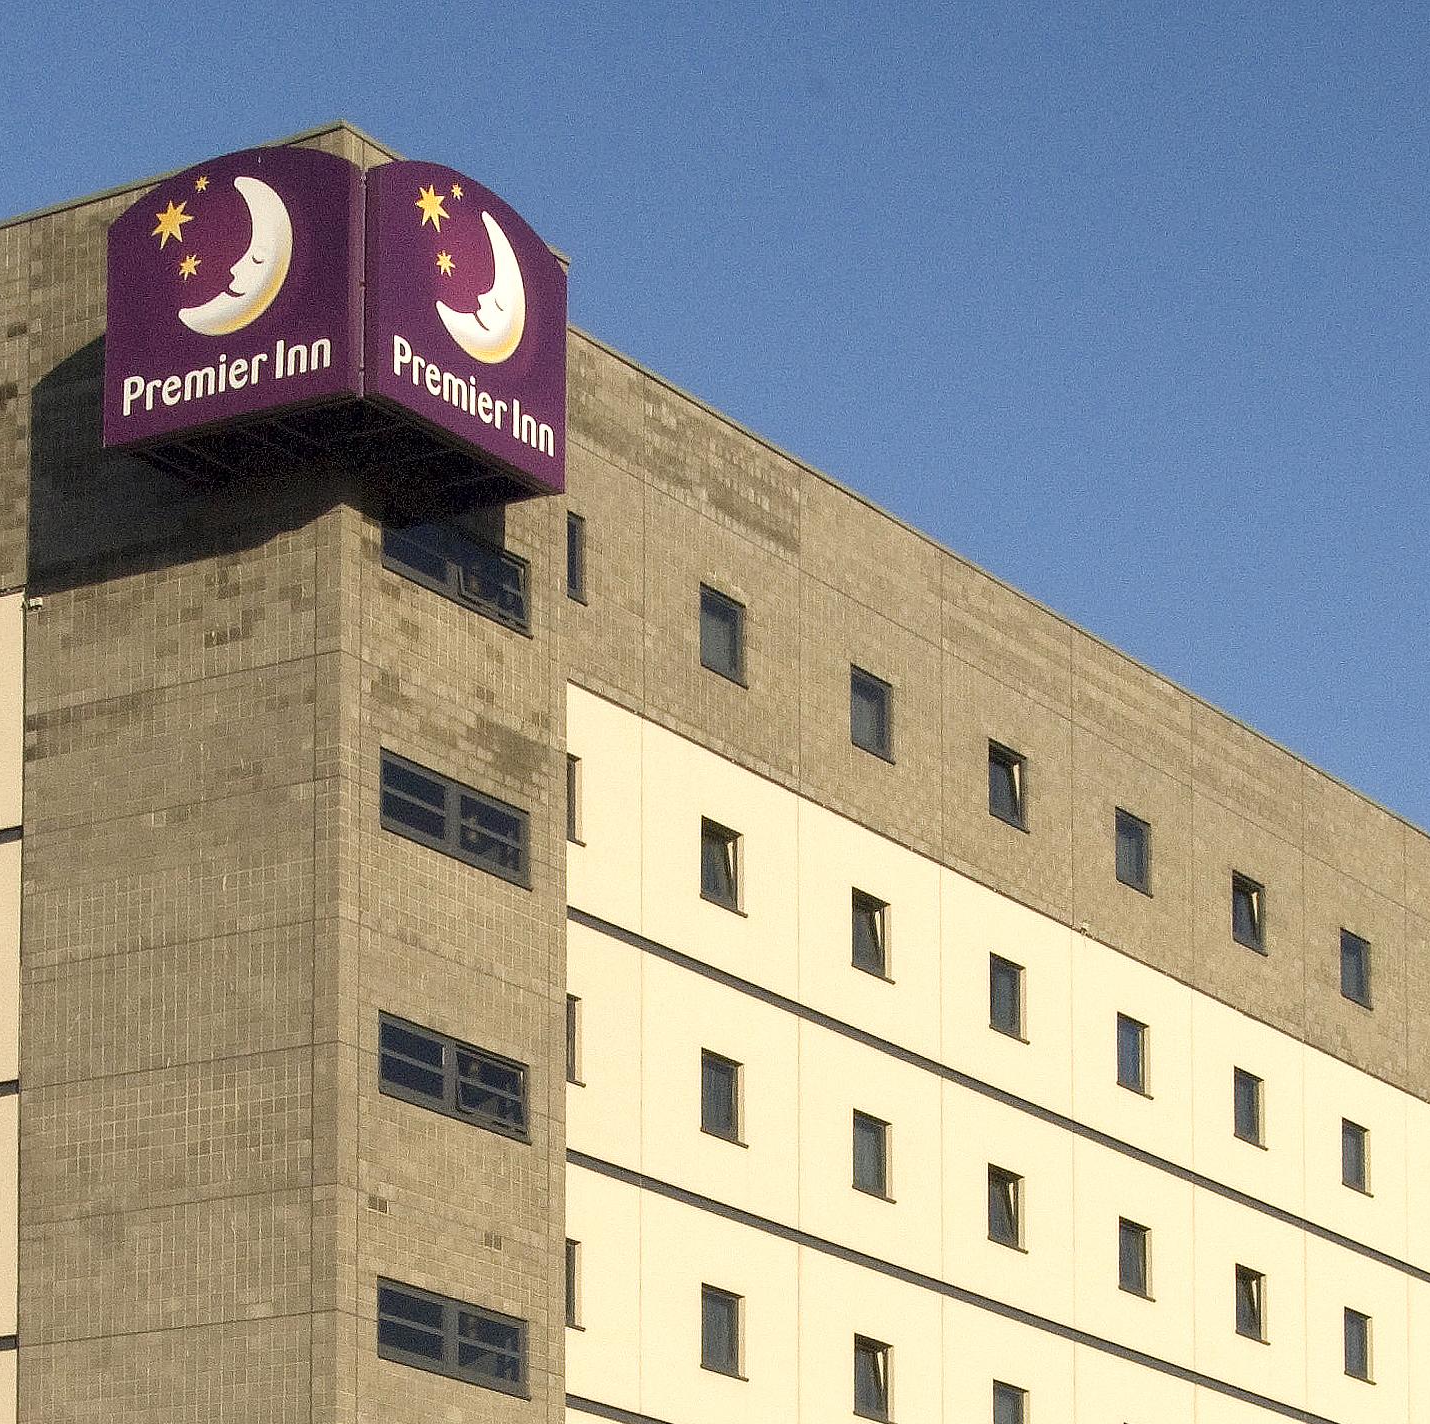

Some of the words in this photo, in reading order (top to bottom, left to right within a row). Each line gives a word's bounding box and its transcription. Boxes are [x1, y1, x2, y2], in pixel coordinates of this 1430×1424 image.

[122, 352, 269, 417] Premier
[275, 337, 331, 380] Inn
[393, 334, 508, 430] Premier
[512, 398, 555, 457] Inn
